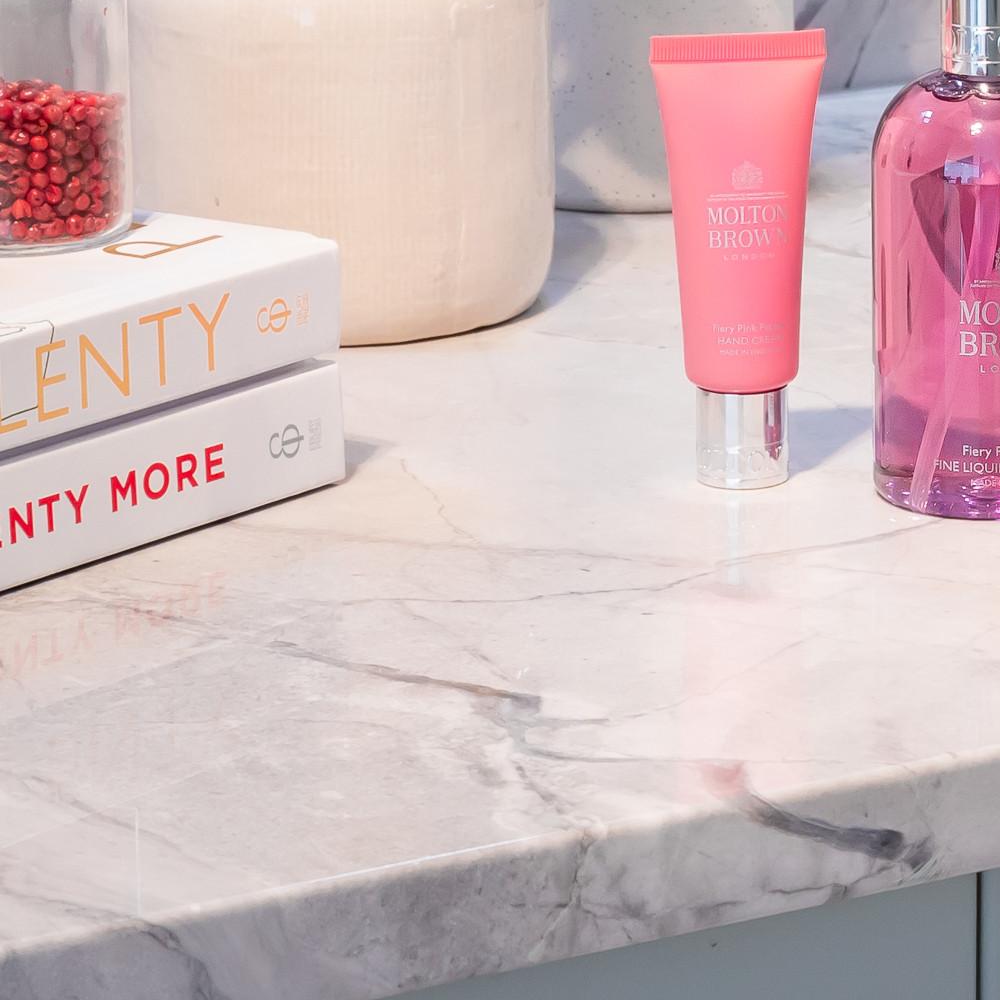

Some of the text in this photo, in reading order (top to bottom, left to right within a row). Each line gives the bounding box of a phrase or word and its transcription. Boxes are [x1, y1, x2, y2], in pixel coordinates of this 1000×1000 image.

[707, 204, 788, 225] MOLTON
[708, 227, 788, 249] BROWN
[962, 444, 992, 460] Fiery
[933, 459, 960, 473] FINE
[0, 443, 225, 548] NTY MORE
